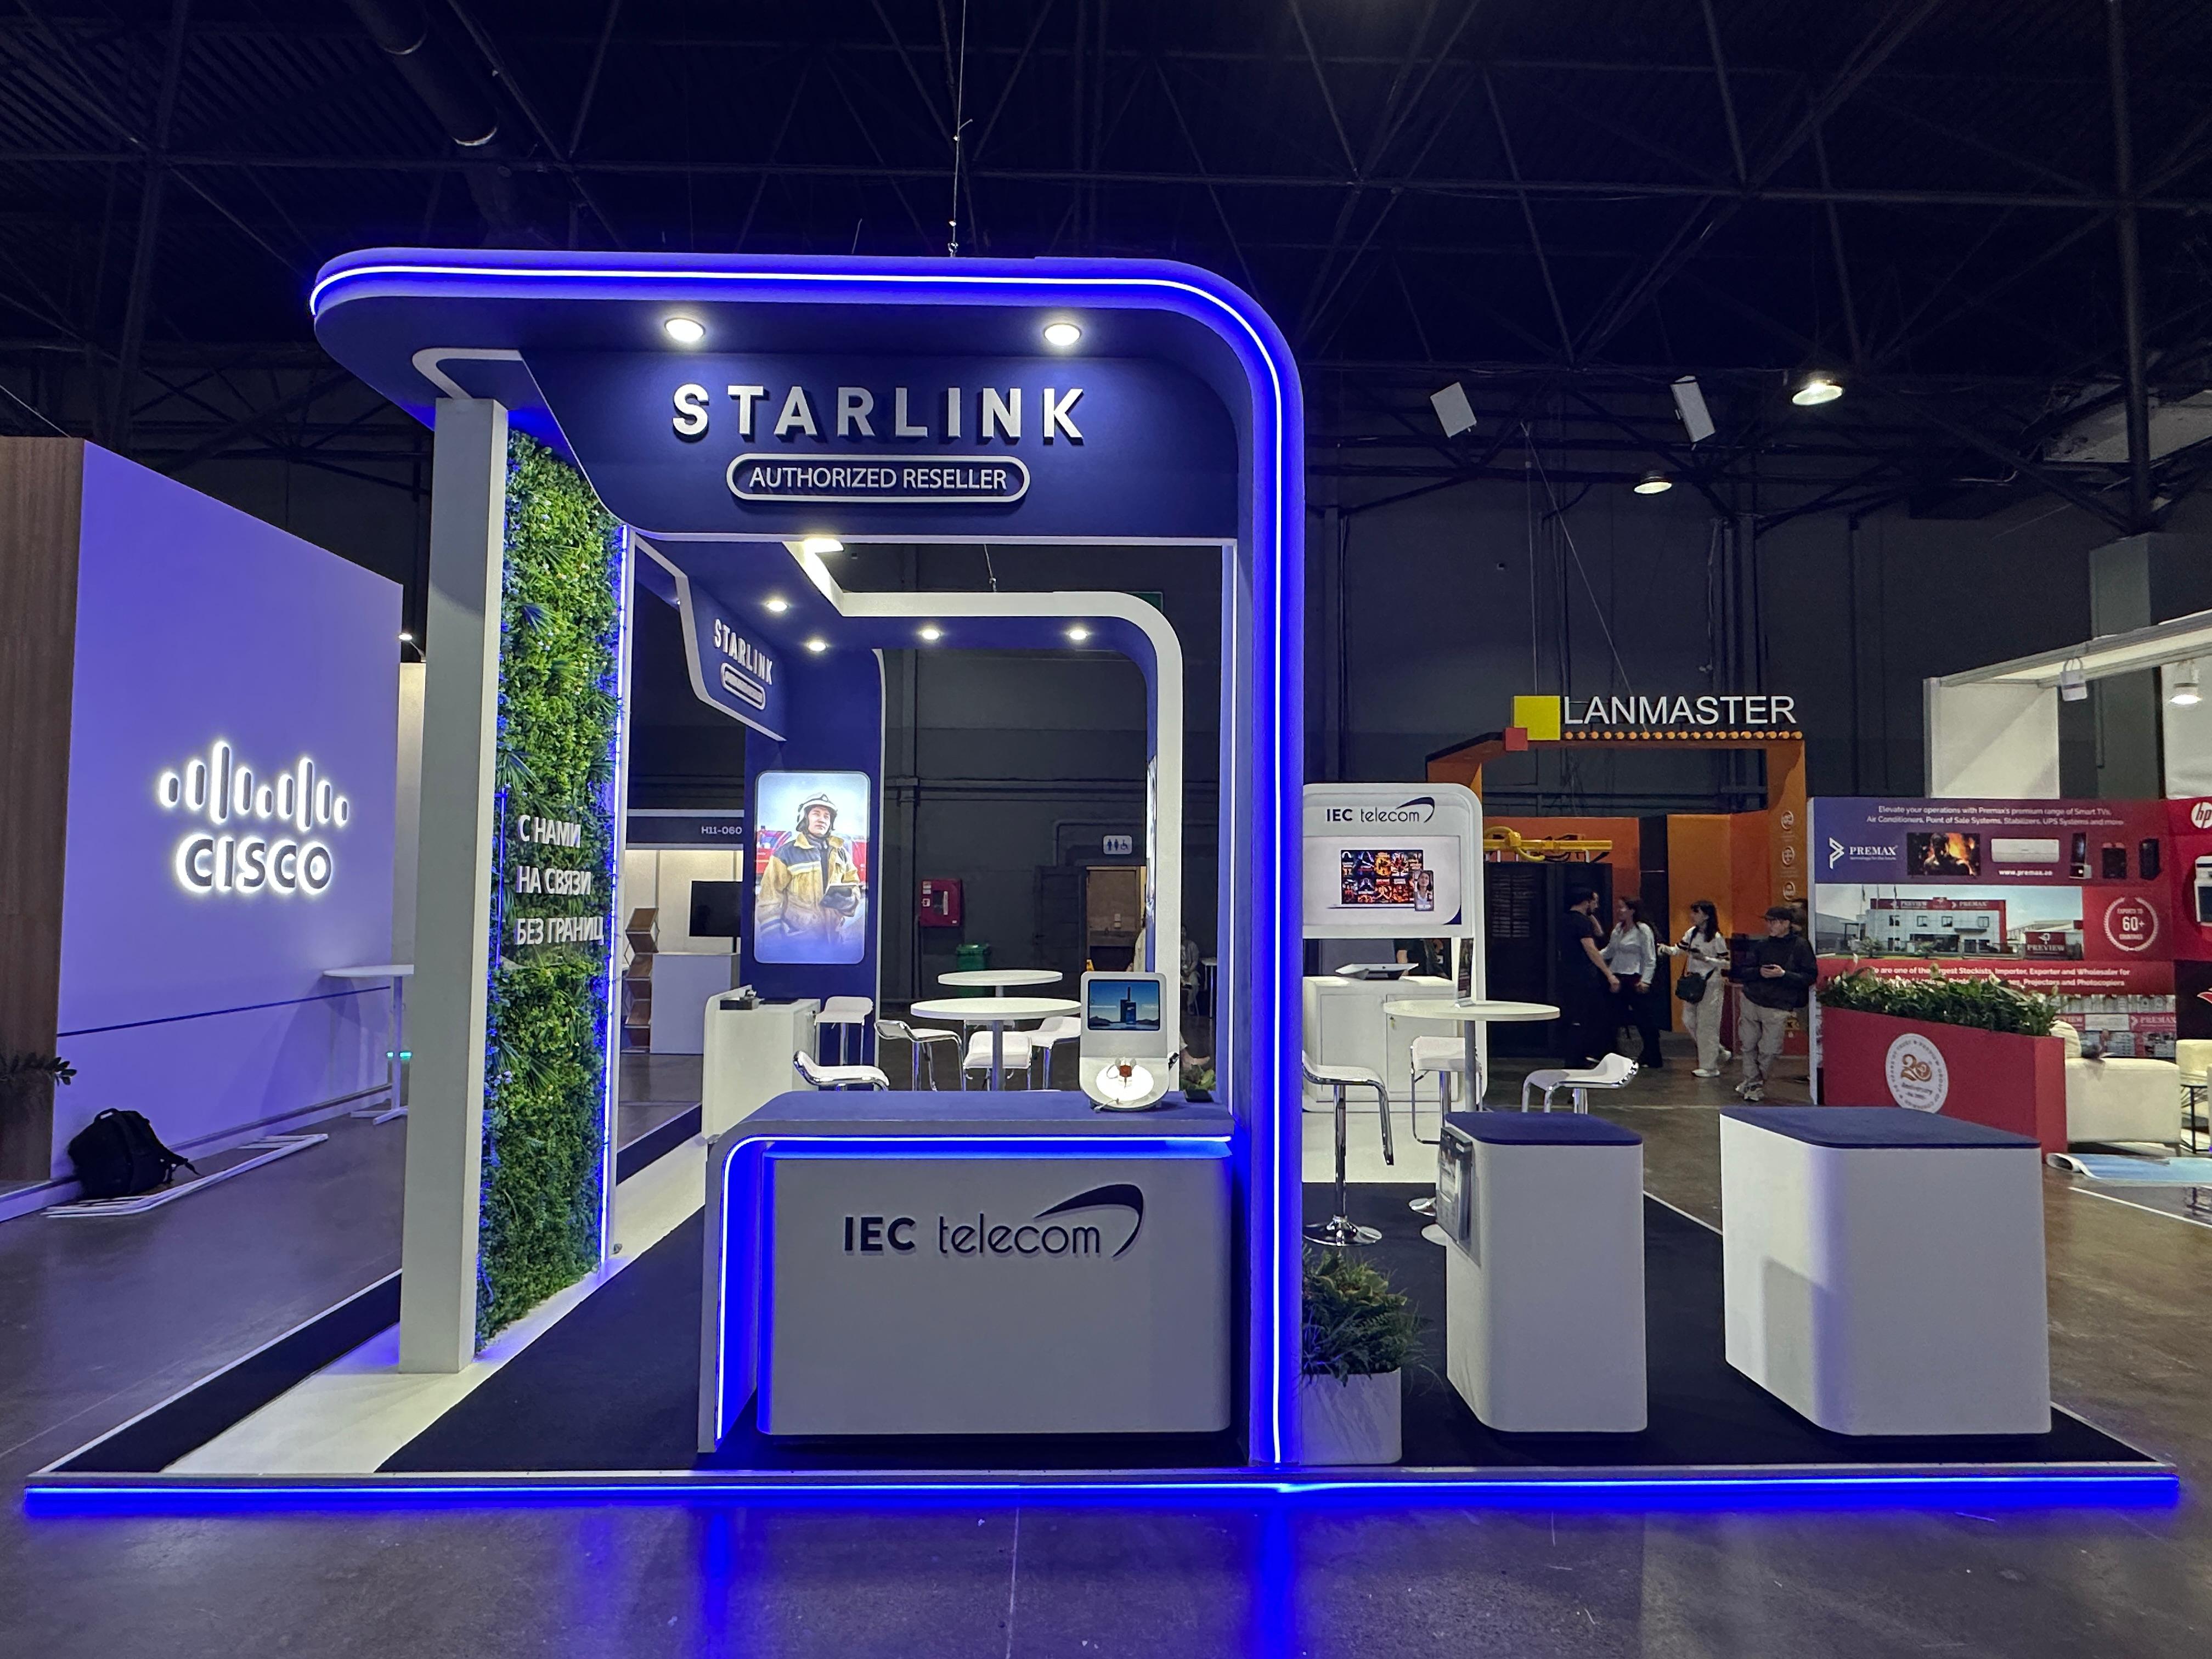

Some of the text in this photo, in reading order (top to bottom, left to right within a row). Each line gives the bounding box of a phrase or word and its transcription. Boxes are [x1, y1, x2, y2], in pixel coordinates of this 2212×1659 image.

[673, 383, 1084, 441] STARLINK
[749, 466, 1007, 490] AUTHORIZED RESELLER
[714, 619, 772, 685] STARLINK
[1564, 696, 1797, 725] LANMASTER
[1327, 807, 1420, 823] IEC telecom
[2195, 802, 2212, 828] hp
[518, 815, 581, 848] С НАМИ
[701, 826, 742, 834] H11-060
[177, 834, 332, 894] CISCO
[1849, 846, 1896, 855] PREMAX
[516, 866, 591, 895] НА СВЯЗИ
[515, 916, 604, 945] БЕЗ ГРАНИЦ
[2123, 916, 2145, 931] 60+
[2029, 968, 2060, 976] Exporter
[845, 1212, 1100, 1254] IEC telecom
